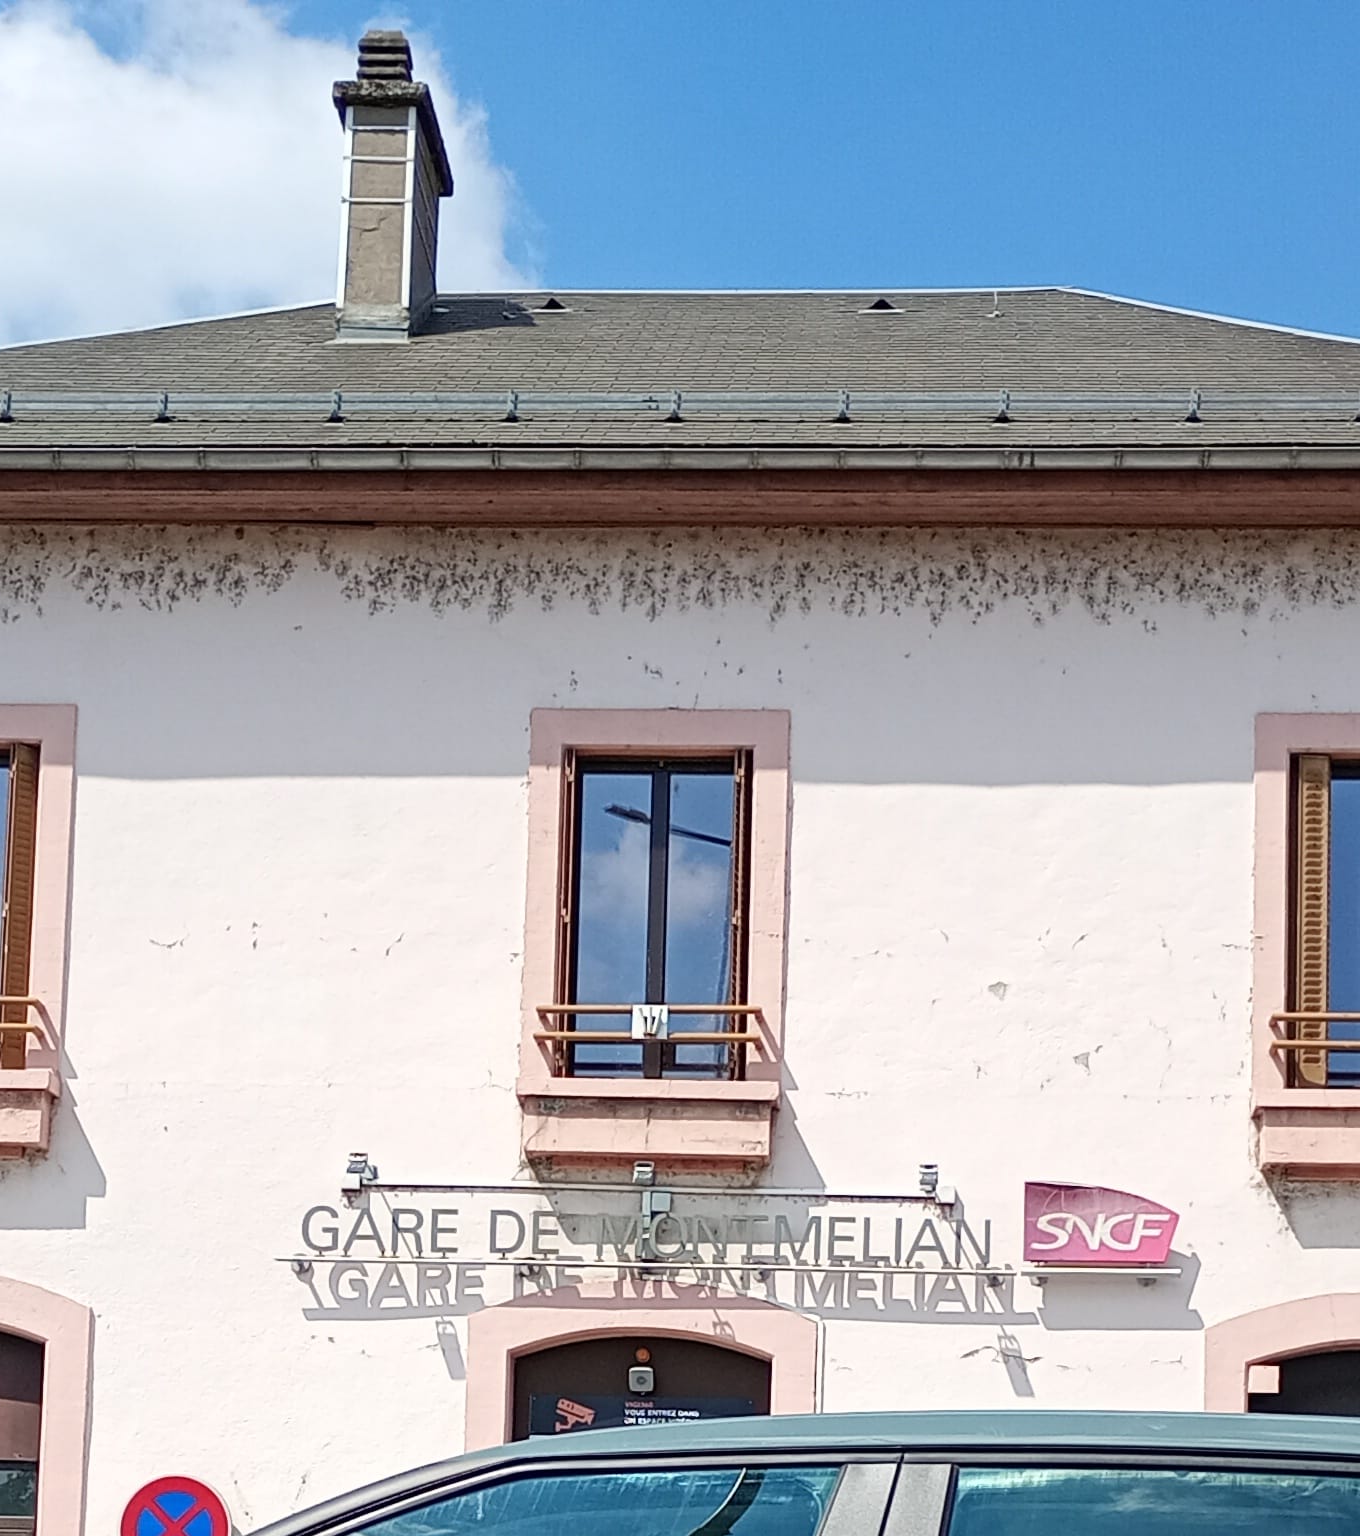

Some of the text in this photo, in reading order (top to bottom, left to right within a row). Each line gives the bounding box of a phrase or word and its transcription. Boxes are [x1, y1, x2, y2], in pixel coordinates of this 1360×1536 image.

[301, 1205, 991, 1267] GARE DE MONTMELIAN
[1030, 1212, 1171, 1251] SNCF
